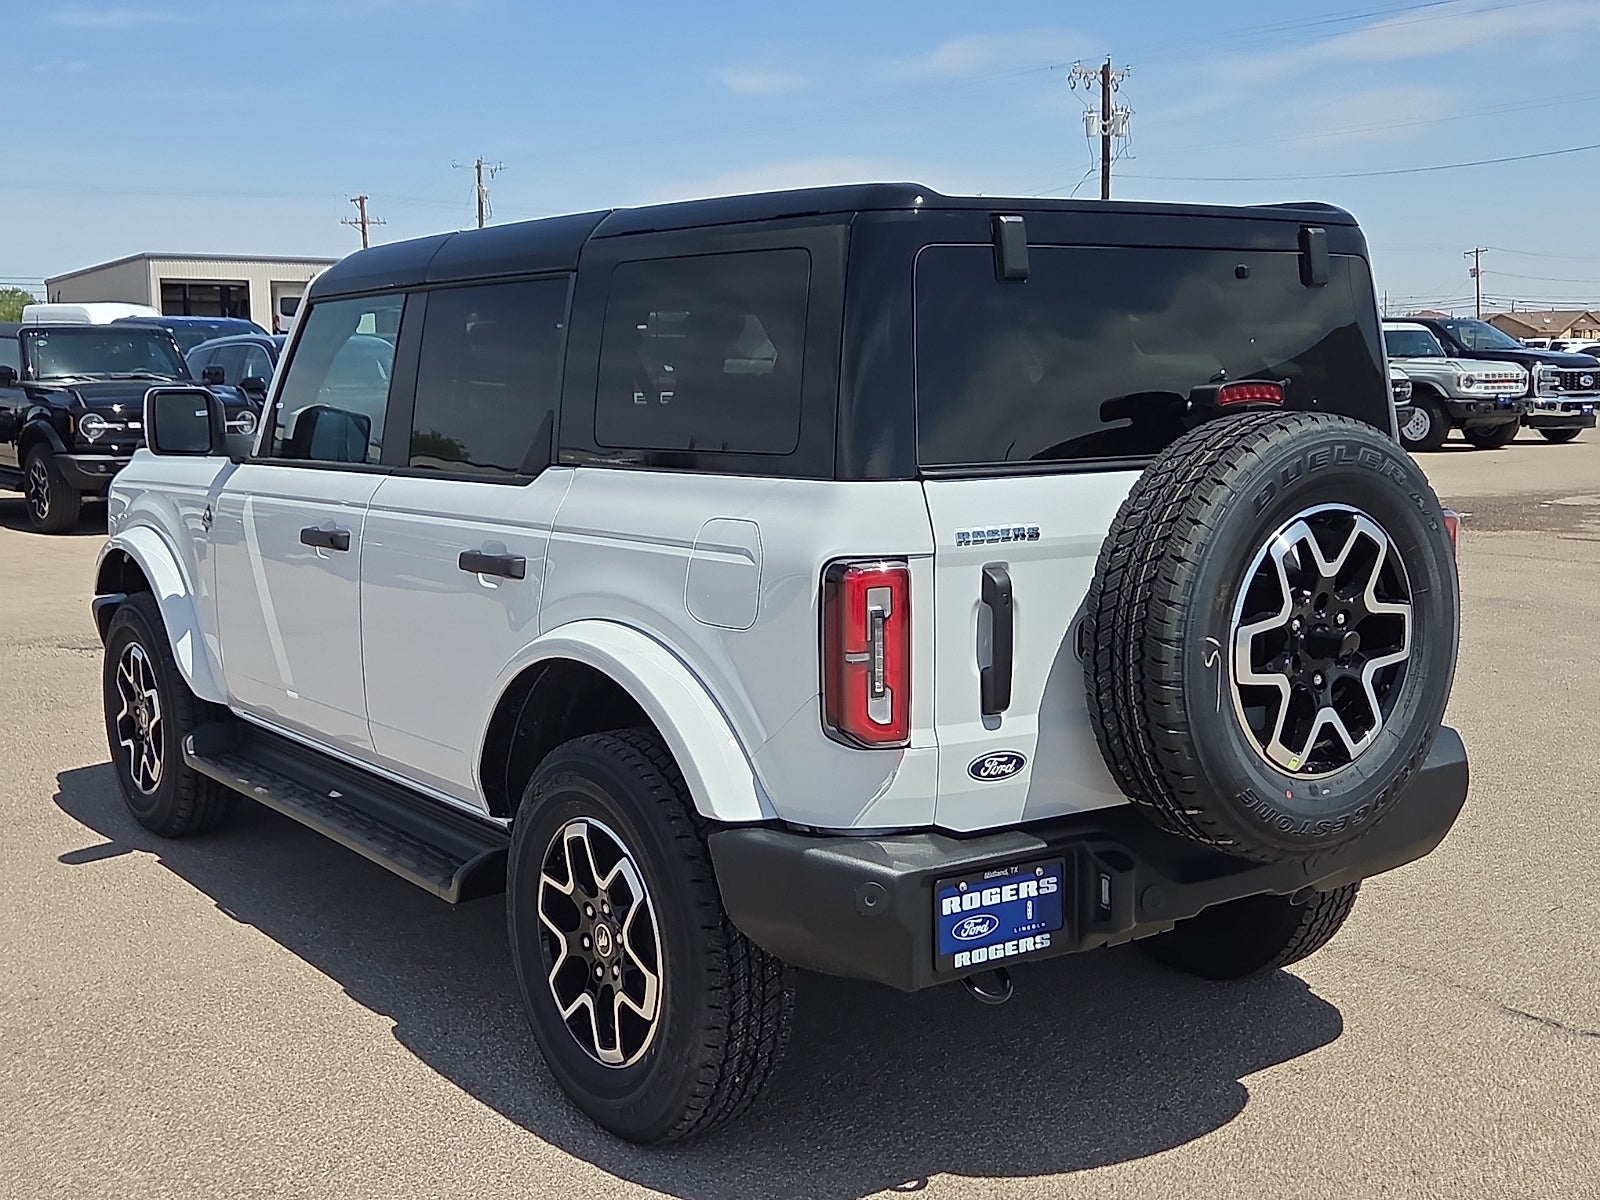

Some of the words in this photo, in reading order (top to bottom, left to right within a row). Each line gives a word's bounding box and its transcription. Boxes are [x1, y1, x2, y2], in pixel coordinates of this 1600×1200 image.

[1250, 445, 1407, 519] DUELER
[955, 526, 1040, 546] ROGERS
[980, 756, 1016, 777] Ford
[1010, 866, 1018, 874] TX
[941, 877, 1058, 916] ROGERS
[960, 918, 990, 937] Ford
[1013, 922, 1046, 933] LINCOLN
[954, 933, 1051, 968] ROGERS
